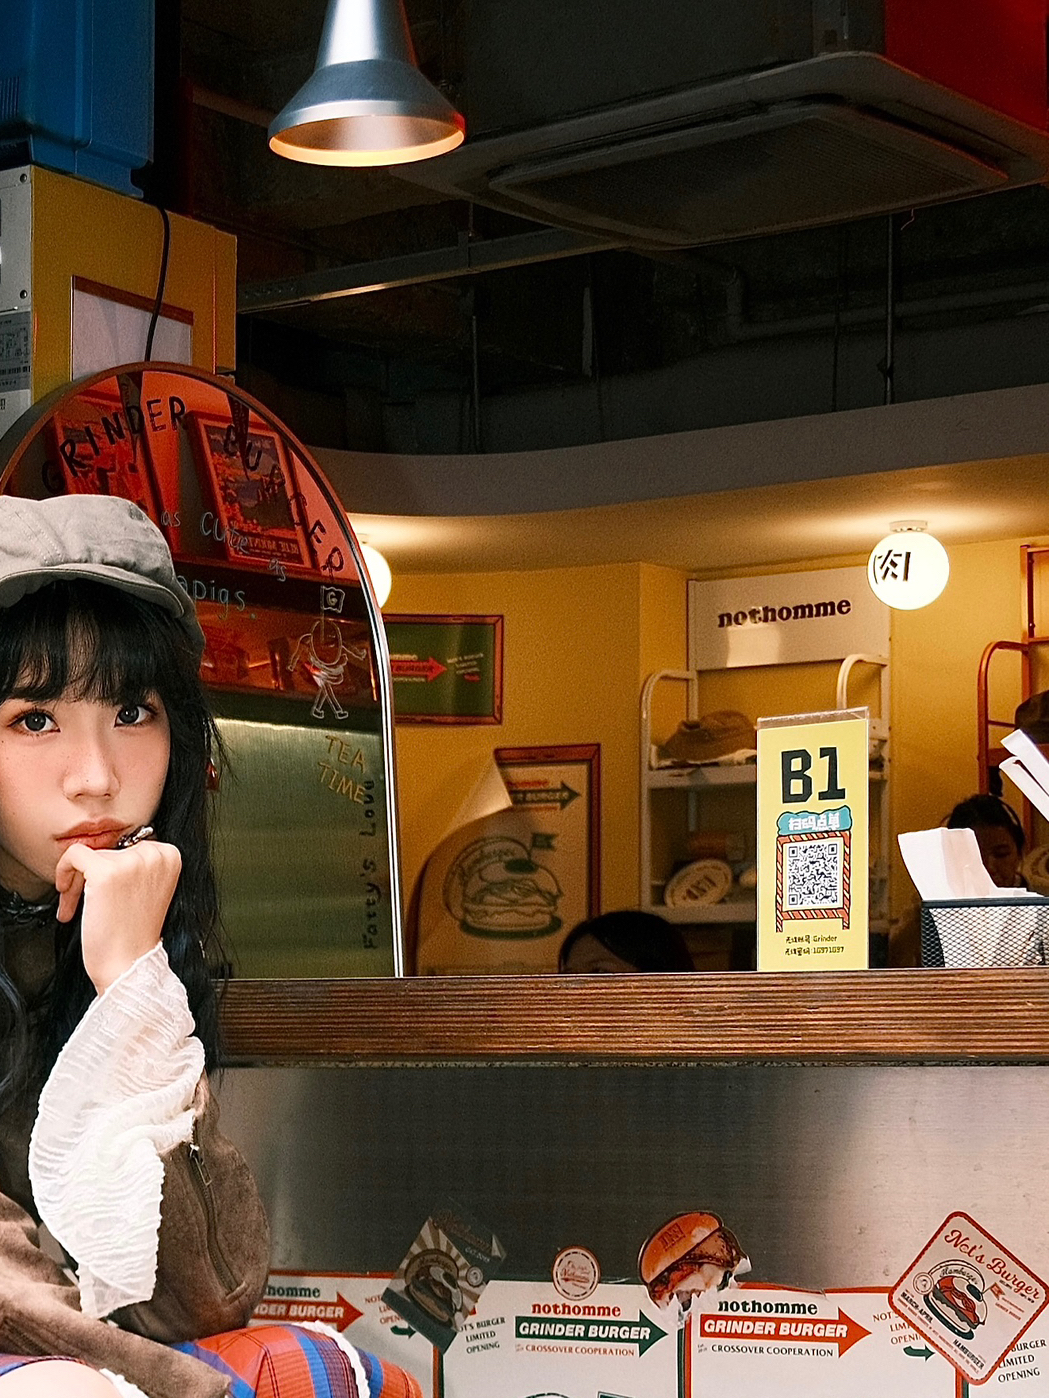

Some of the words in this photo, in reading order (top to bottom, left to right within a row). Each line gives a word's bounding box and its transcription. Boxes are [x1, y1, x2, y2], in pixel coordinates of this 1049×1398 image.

[41, 395, 187, 494] GRINDER
[717, 599, 852, 629] nothomme
[325, 734, 367, 775] TEA
[317, 760, 368, 805] TIME
[780, 746, 847, 805] B1
[787, 811, 841, 832] 扫码点单
[986, 1257, 1041, 1300] Burger
[288, 1304, 345, 1319] BURGER
[531, 1302, 622, 1318] nothomme
[717, 1299, 818, 1316] nothomme
[475, 1316, 506, 1329] BURGER
[518, 1321, 586, 1338] GRINDER
[587, 1325, 651, 1341] BURGER
[703, 1319, 777, 1336] GRINDER
[778, 1321, 849, 1338] BURGER
[465, 1329, 497, 1343] LIMITED
[465, 1341, 501, 1354] OPENING
[525, 1344, 574, 1355] CROSSOVER
[574, 1346, 635, 1357] COOPERATION
[711, 1344, 765, 1355] CROSSOVER
[766, 1346, 834, 1358] COOPERATION
[997, 1367, 1041, 1383] OPENING
